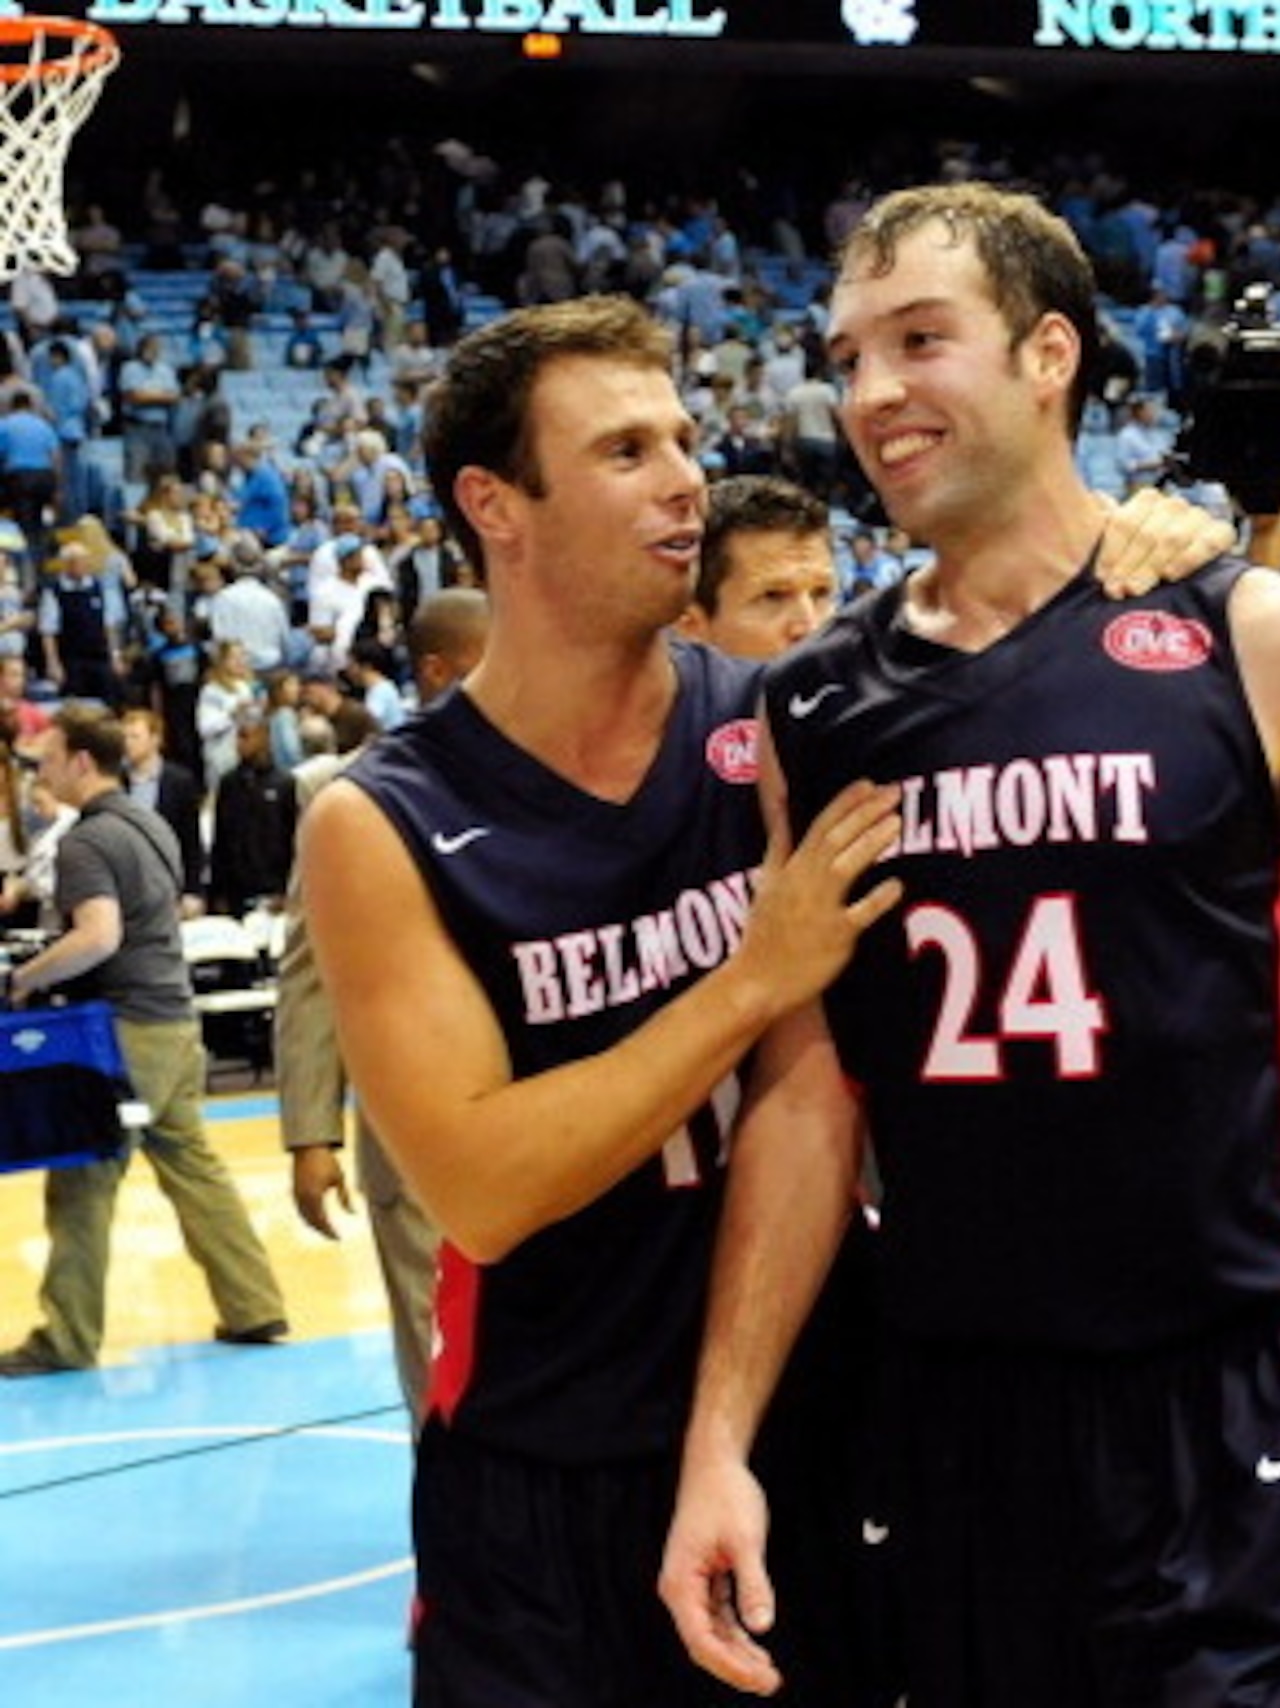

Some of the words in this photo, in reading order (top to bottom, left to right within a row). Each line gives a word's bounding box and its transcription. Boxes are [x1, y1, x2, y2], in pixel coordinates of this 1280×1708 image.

[877, 752, 1157, 862] LMONT
[511, 866, 763, 1025] BELMON
[904, 891, 1106, 1082] 24
